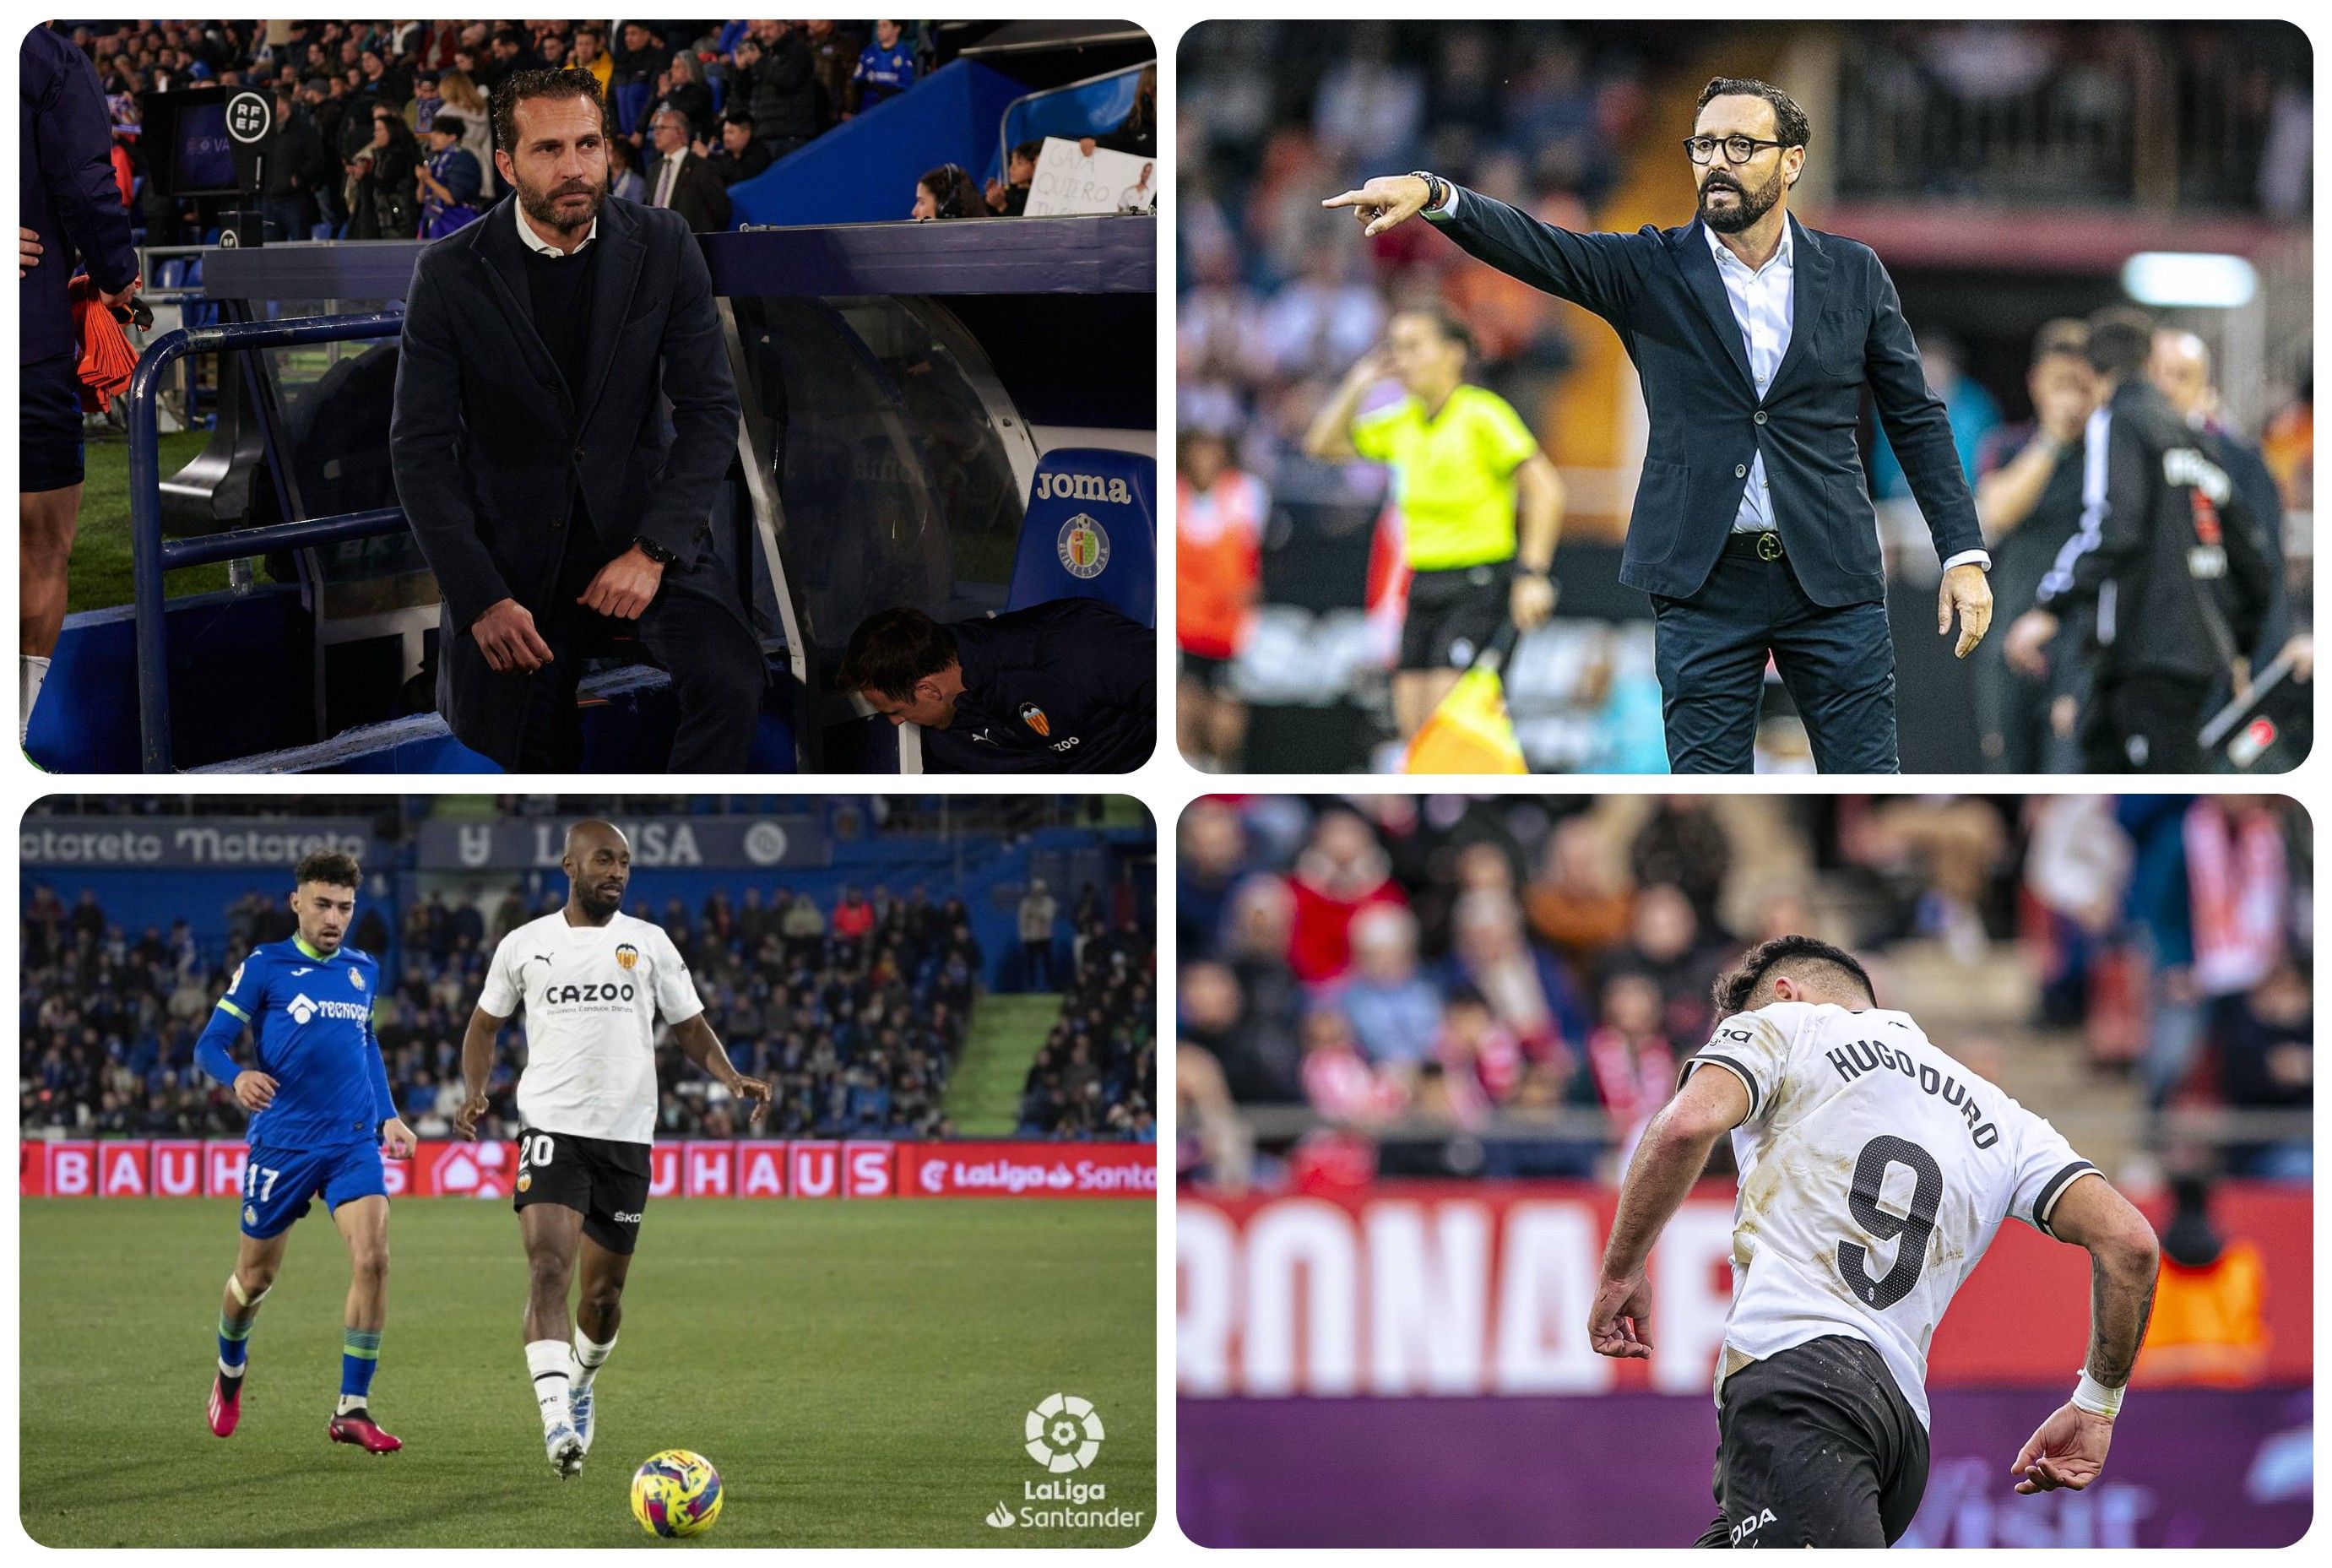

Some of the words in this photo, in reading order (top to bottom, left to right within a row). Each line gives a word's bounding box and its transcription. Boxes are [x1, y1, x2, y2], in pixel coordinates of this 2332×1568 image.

[546, 983, 634, 1005] CAZOO
[518, 1134, 555, 1171] 20
[248, 1163, 280, 1202] 17
[1836, 1134, 1943, 1311] 9
